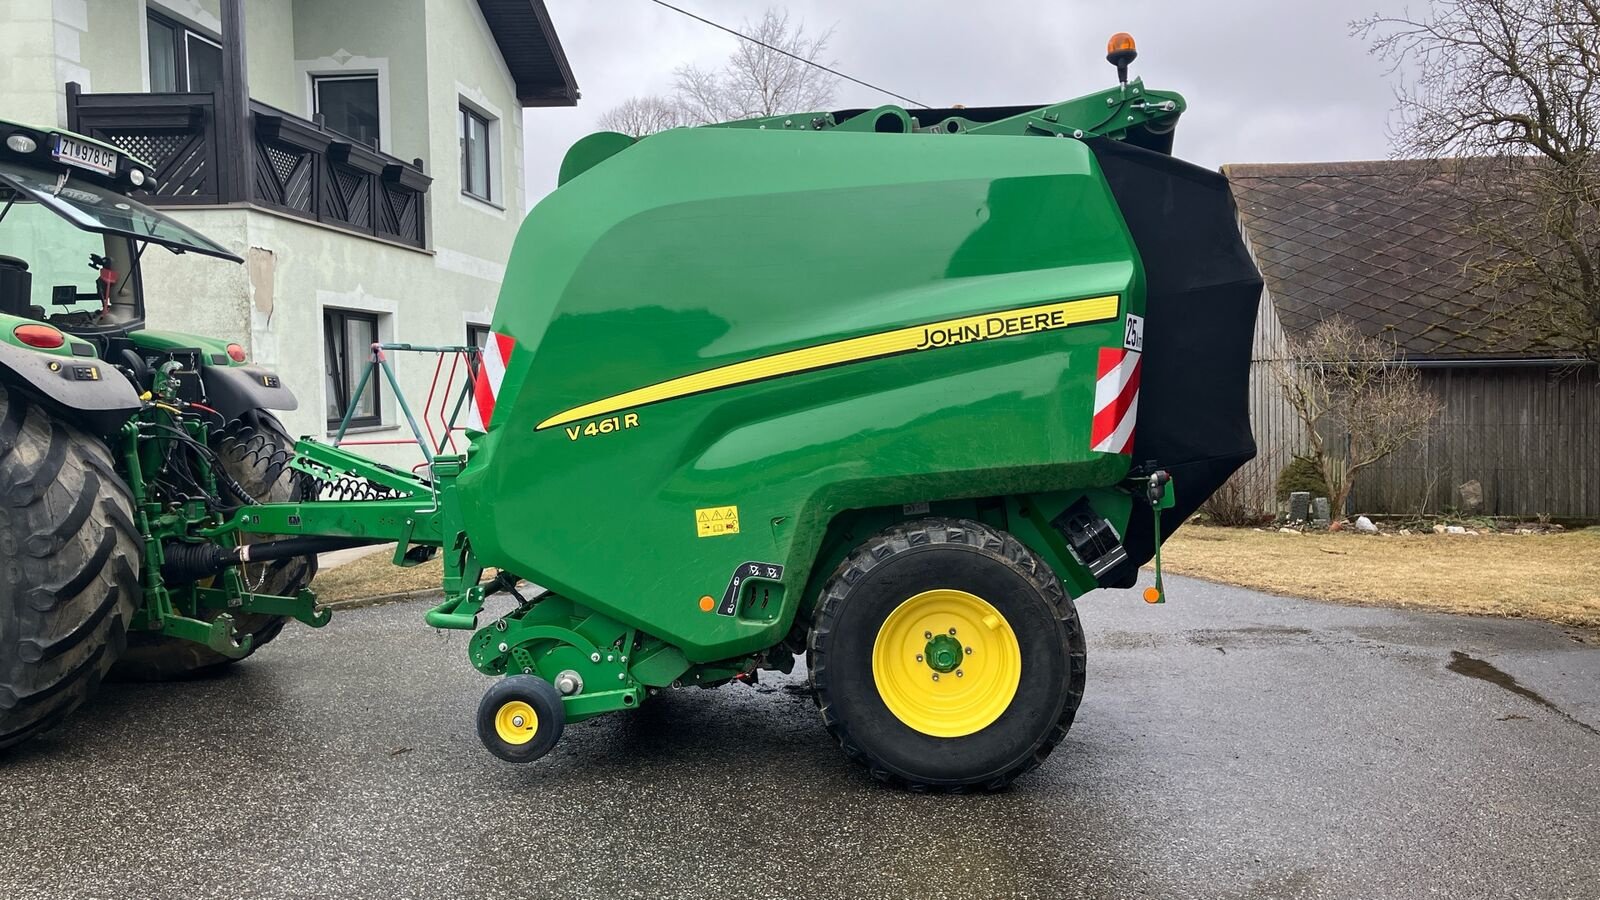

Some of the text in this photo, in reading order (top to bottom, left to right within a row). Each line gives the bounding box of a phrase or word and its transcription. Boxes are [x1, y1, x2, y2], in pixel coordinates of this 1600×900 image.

[62, 139, 75, 156] ZT
[81, 145, 99, 164] 978
[101, 152, 114, 167] CF
[916, 310, 1064, 348] JOHN DEERE
[1126, 317, 1138, 347] 25
[566, 413, 639, 440] V 461 R
